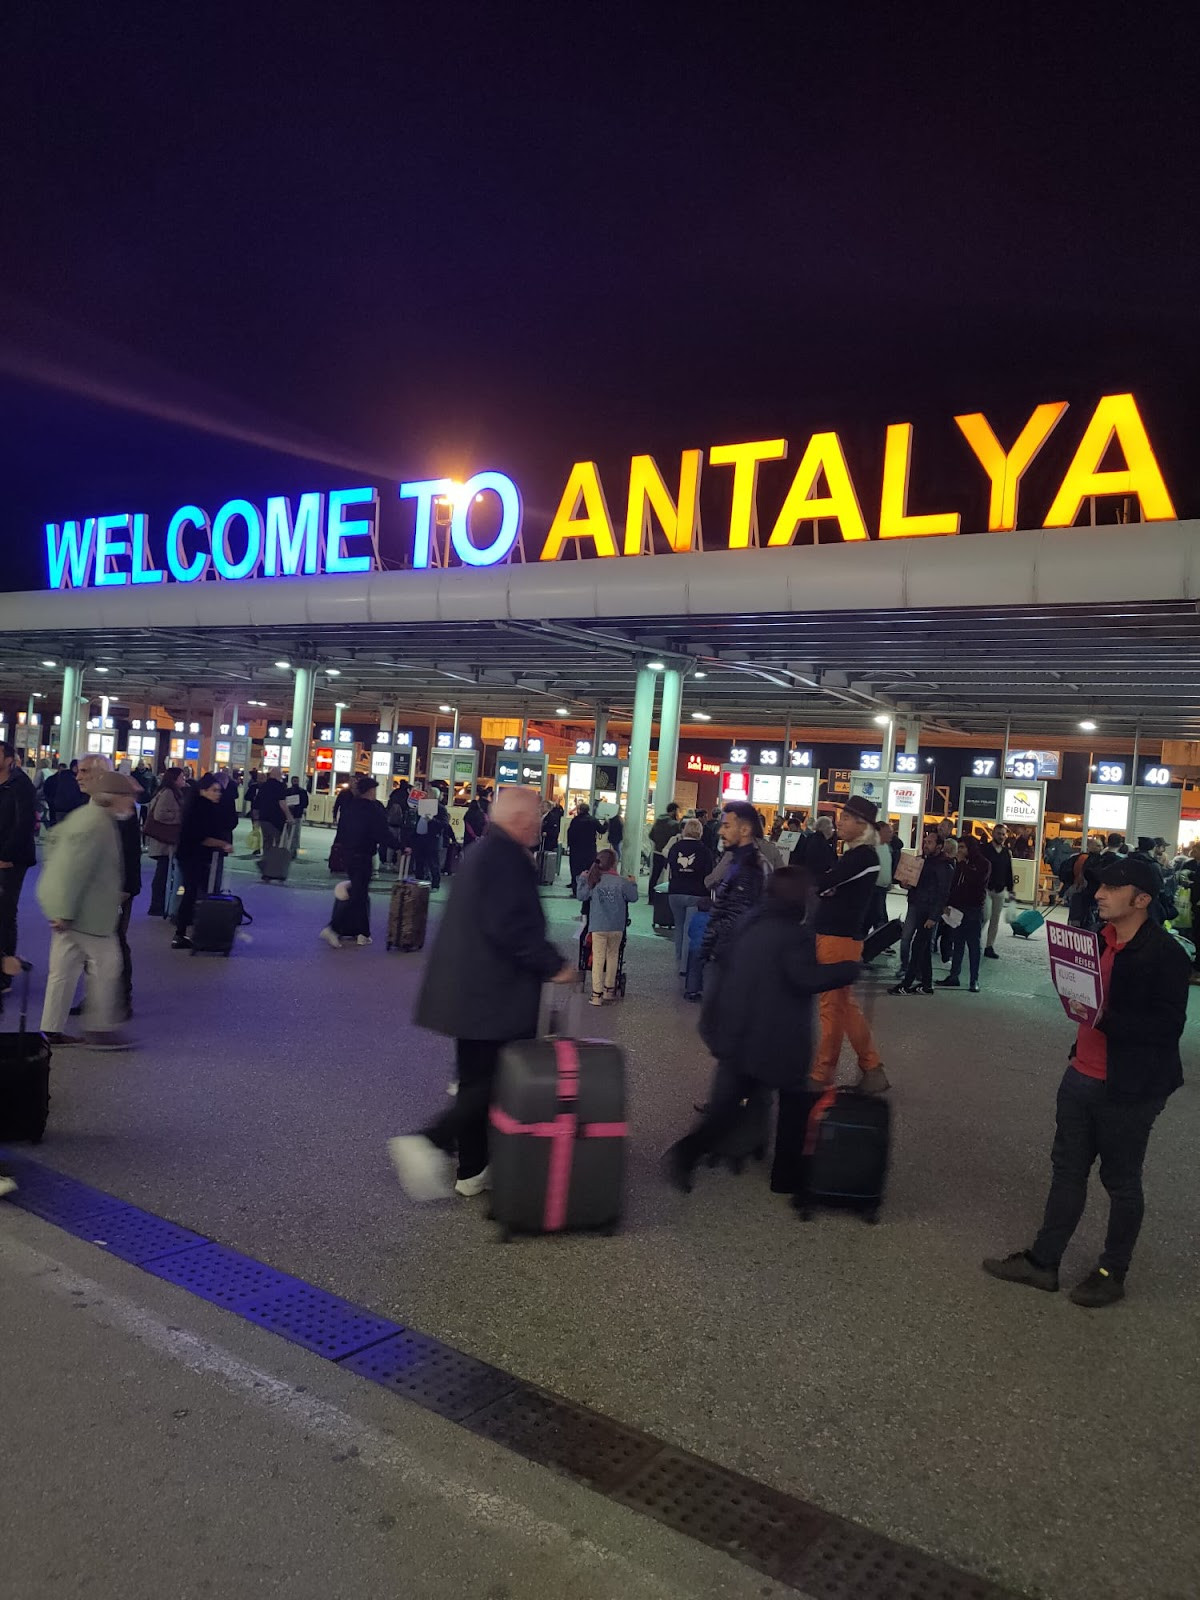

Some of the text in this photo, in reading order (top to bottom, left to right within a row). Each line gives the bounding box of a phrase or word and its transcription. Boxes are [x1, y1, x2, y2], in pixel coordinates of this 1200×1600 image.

[45, 393, 1178, 589] WELCOME TO ANTALYA
[220, 724, 230, 735] 17
[320, 729, 332, 741] 21
[503, 737, 518, 751] 27
[575, 741, 591, 755] 29
[601, 742, 617, 756] 30
[729, 748, 748, 763] 32
[759, 749, 778, 764] 33
[792, 750, 810, 766] 34
[860, 754, 880, 769] 35
[896, 756, 917, 772] 36
[972, 759, 995, 776] 37
[1013, 761, 1036, 778] 38
[1099, 765, 1123, 783] 39
[1144, 767, 1170, 785] 40
[1005, 805, 1036, 815] FIBULA
[452, 818, 460, 826] 26
[1048, 925, 1095, 957] BENTOUR
[1074, 955, 1096, 970] REISEN
